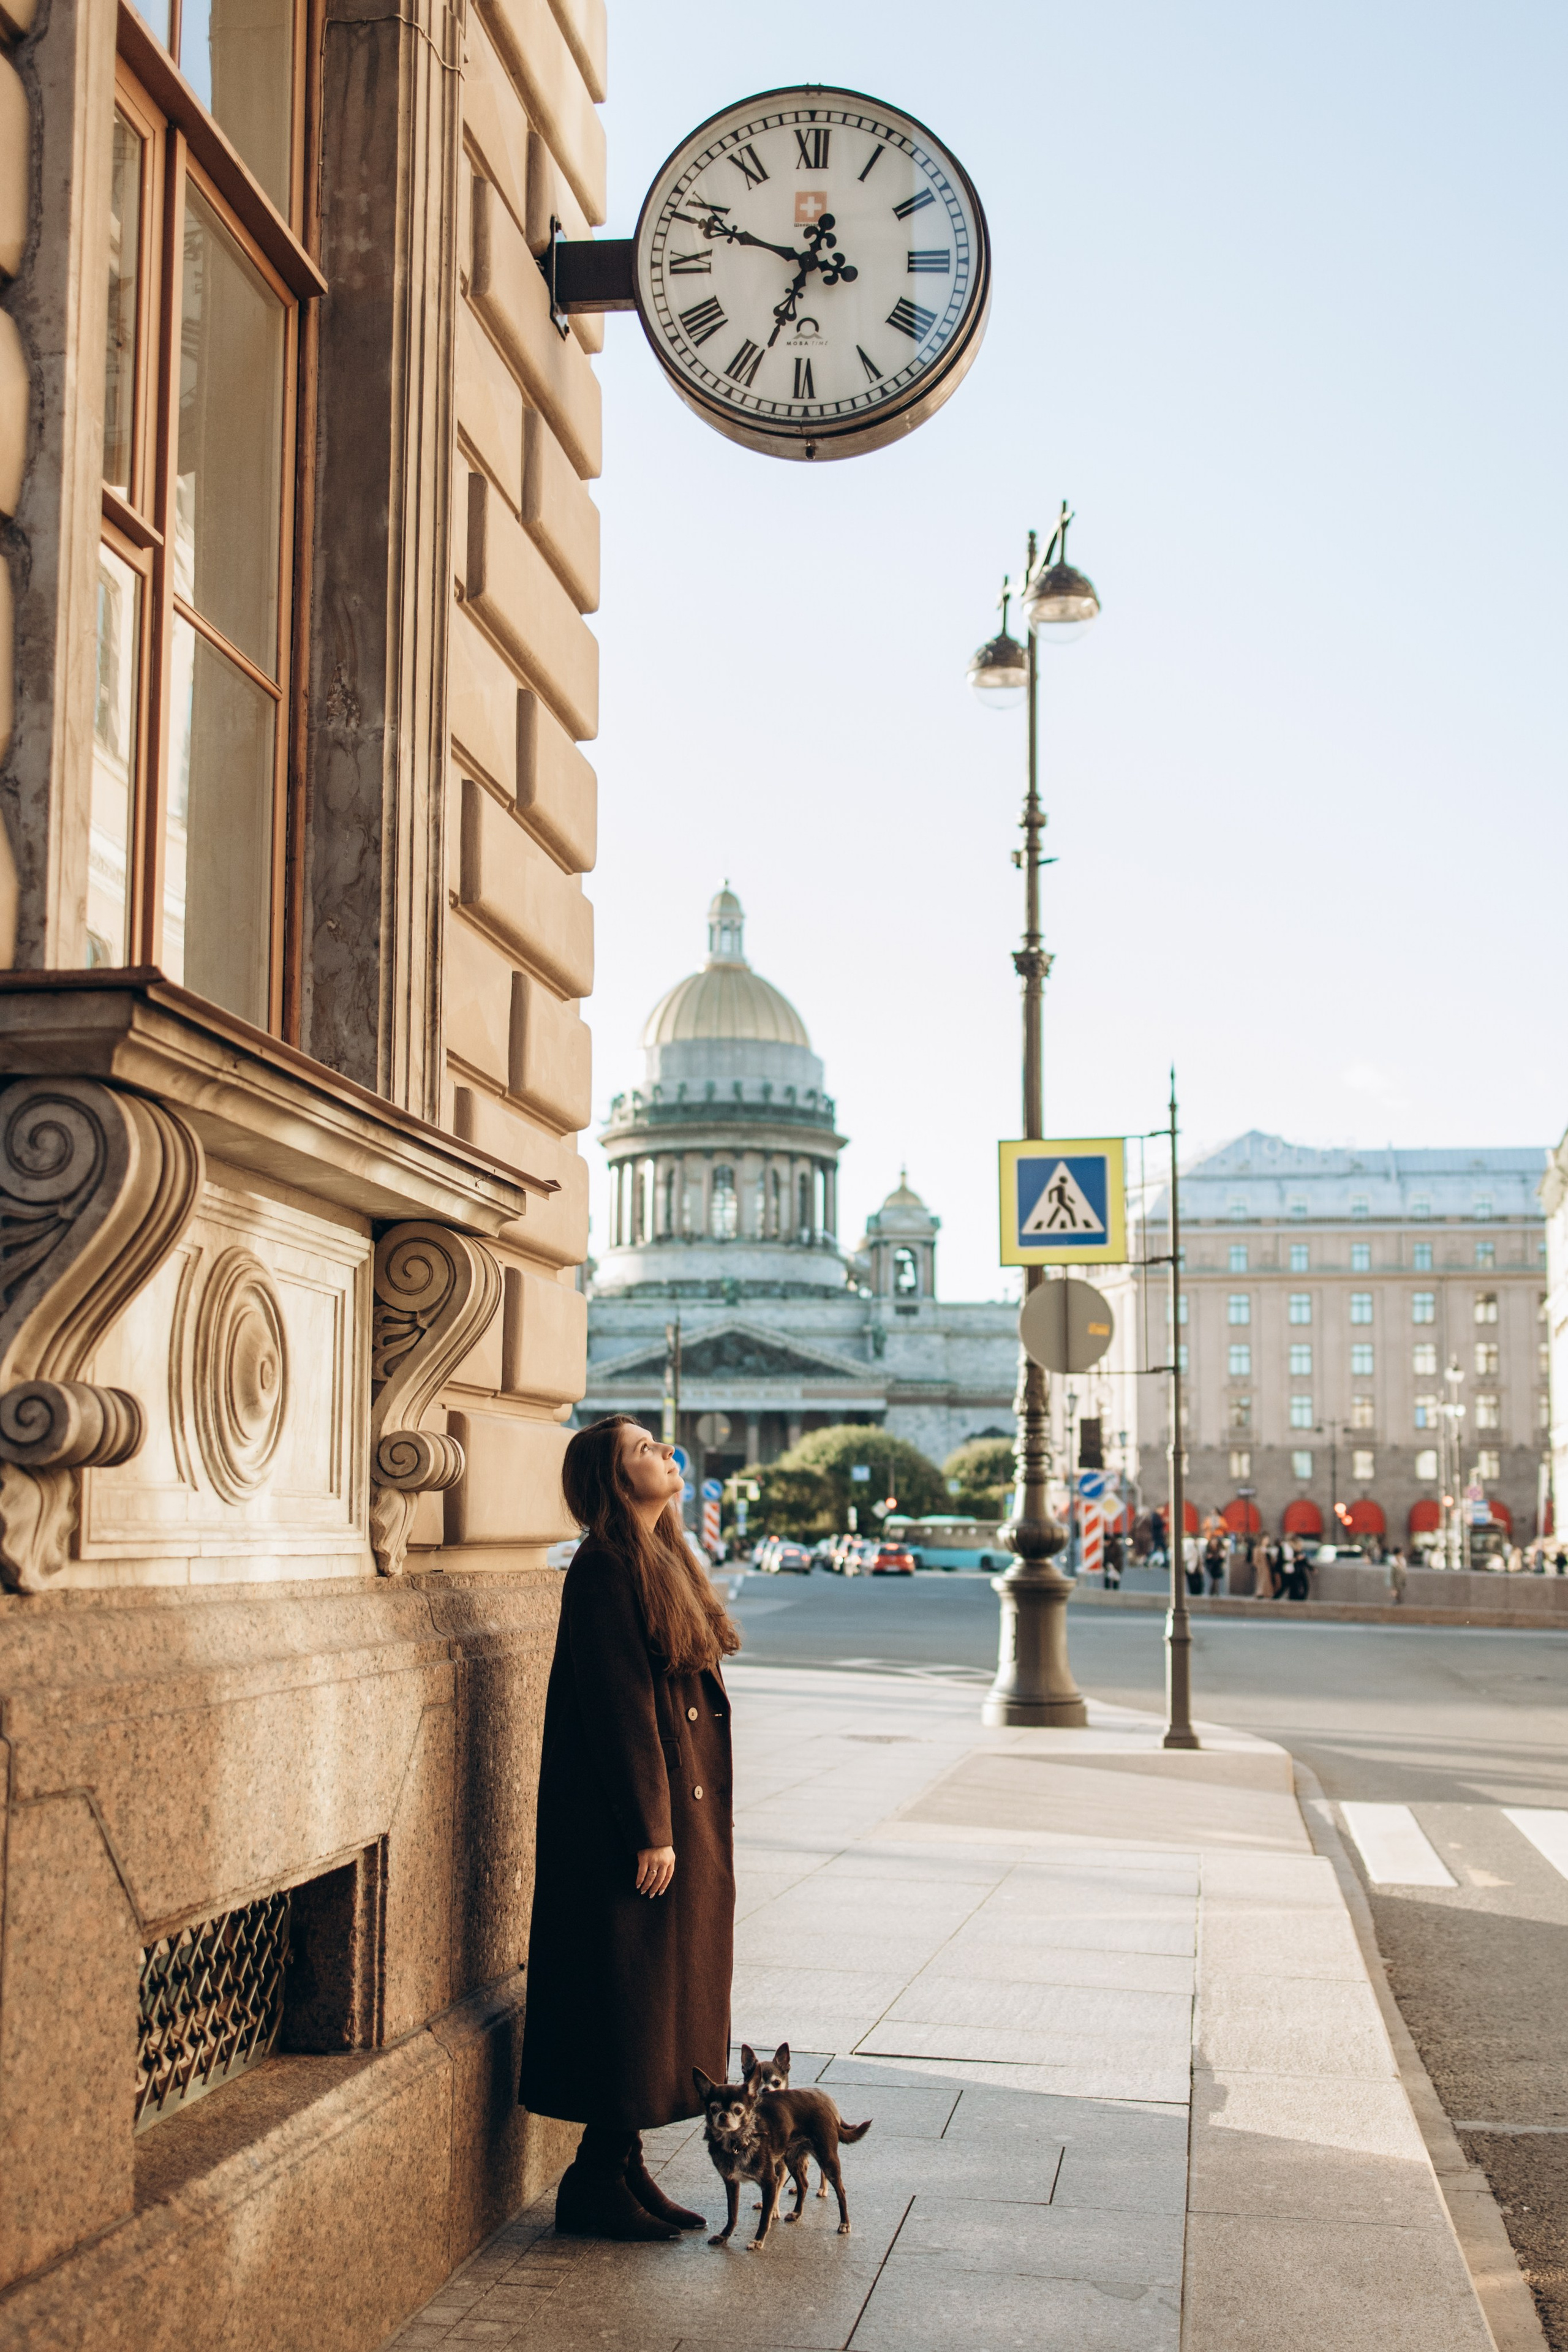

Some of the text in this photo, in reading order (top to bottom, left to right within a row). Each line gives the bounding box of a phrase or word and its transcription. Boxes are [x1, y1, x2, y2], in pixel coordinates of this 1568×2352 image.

[727, 143, 770, 190] XI
[794, 129, 832, 169] XII
[858, 144, 885, 183] I
[686, 191, 731, 224] X
[892, 187, 936, 221] II
[669, 249, 712, 276] IX
[907, 249, 949, 274] III
[678, 295, 728, 348] VIII
[885, 296, 938, 344] IIII
[723, 339, 765, 388] VII
[792, 358, 816, 399] VI
[856, 345, 883, 384] V
